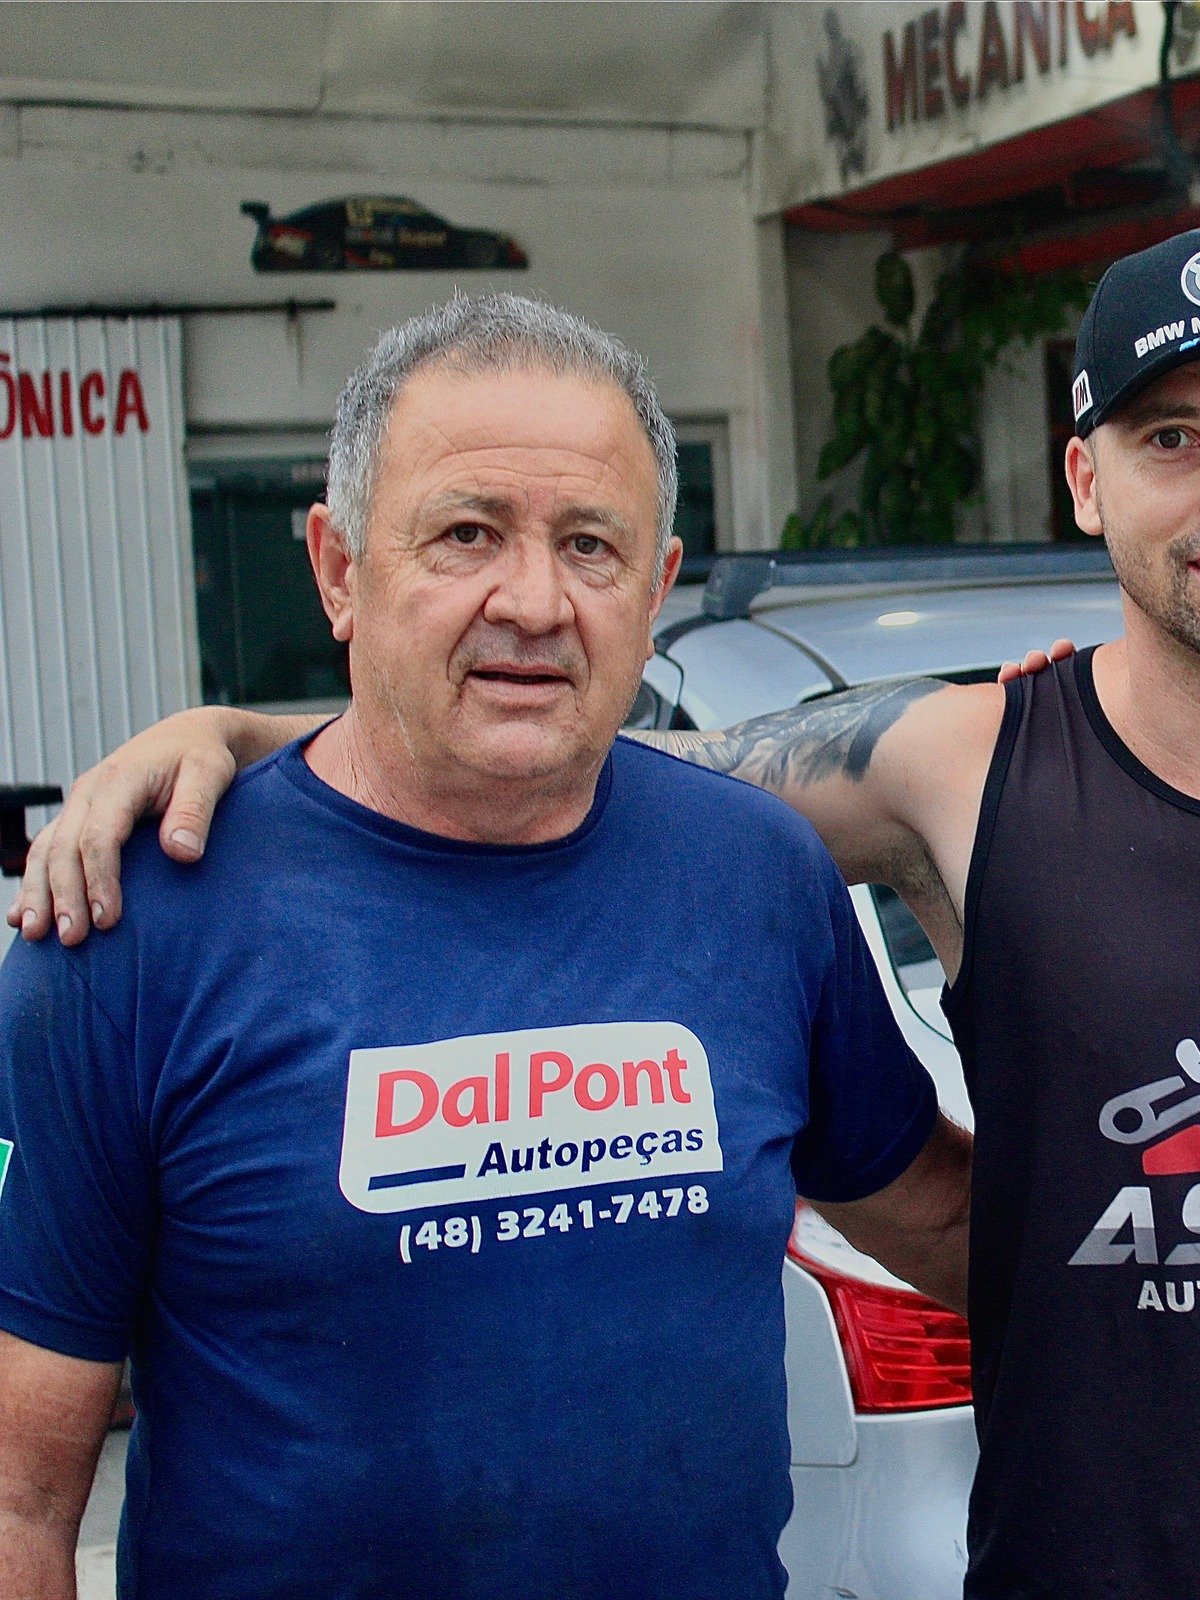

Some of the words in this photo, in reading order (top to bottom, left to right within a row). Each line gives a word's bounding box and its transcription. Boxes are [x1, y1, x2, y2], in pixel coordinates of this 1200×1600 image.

[1134, 320, 1185, 359] BMW
[374, 1052, 510, 1138] Dal
[528, 1048, 692, 1118] Pont
[476, 1127, 704, 1178] Autopeças
[399, 1214, 481, 1264] (48)
[496, 1184, 710, 1241] 3241-7478
